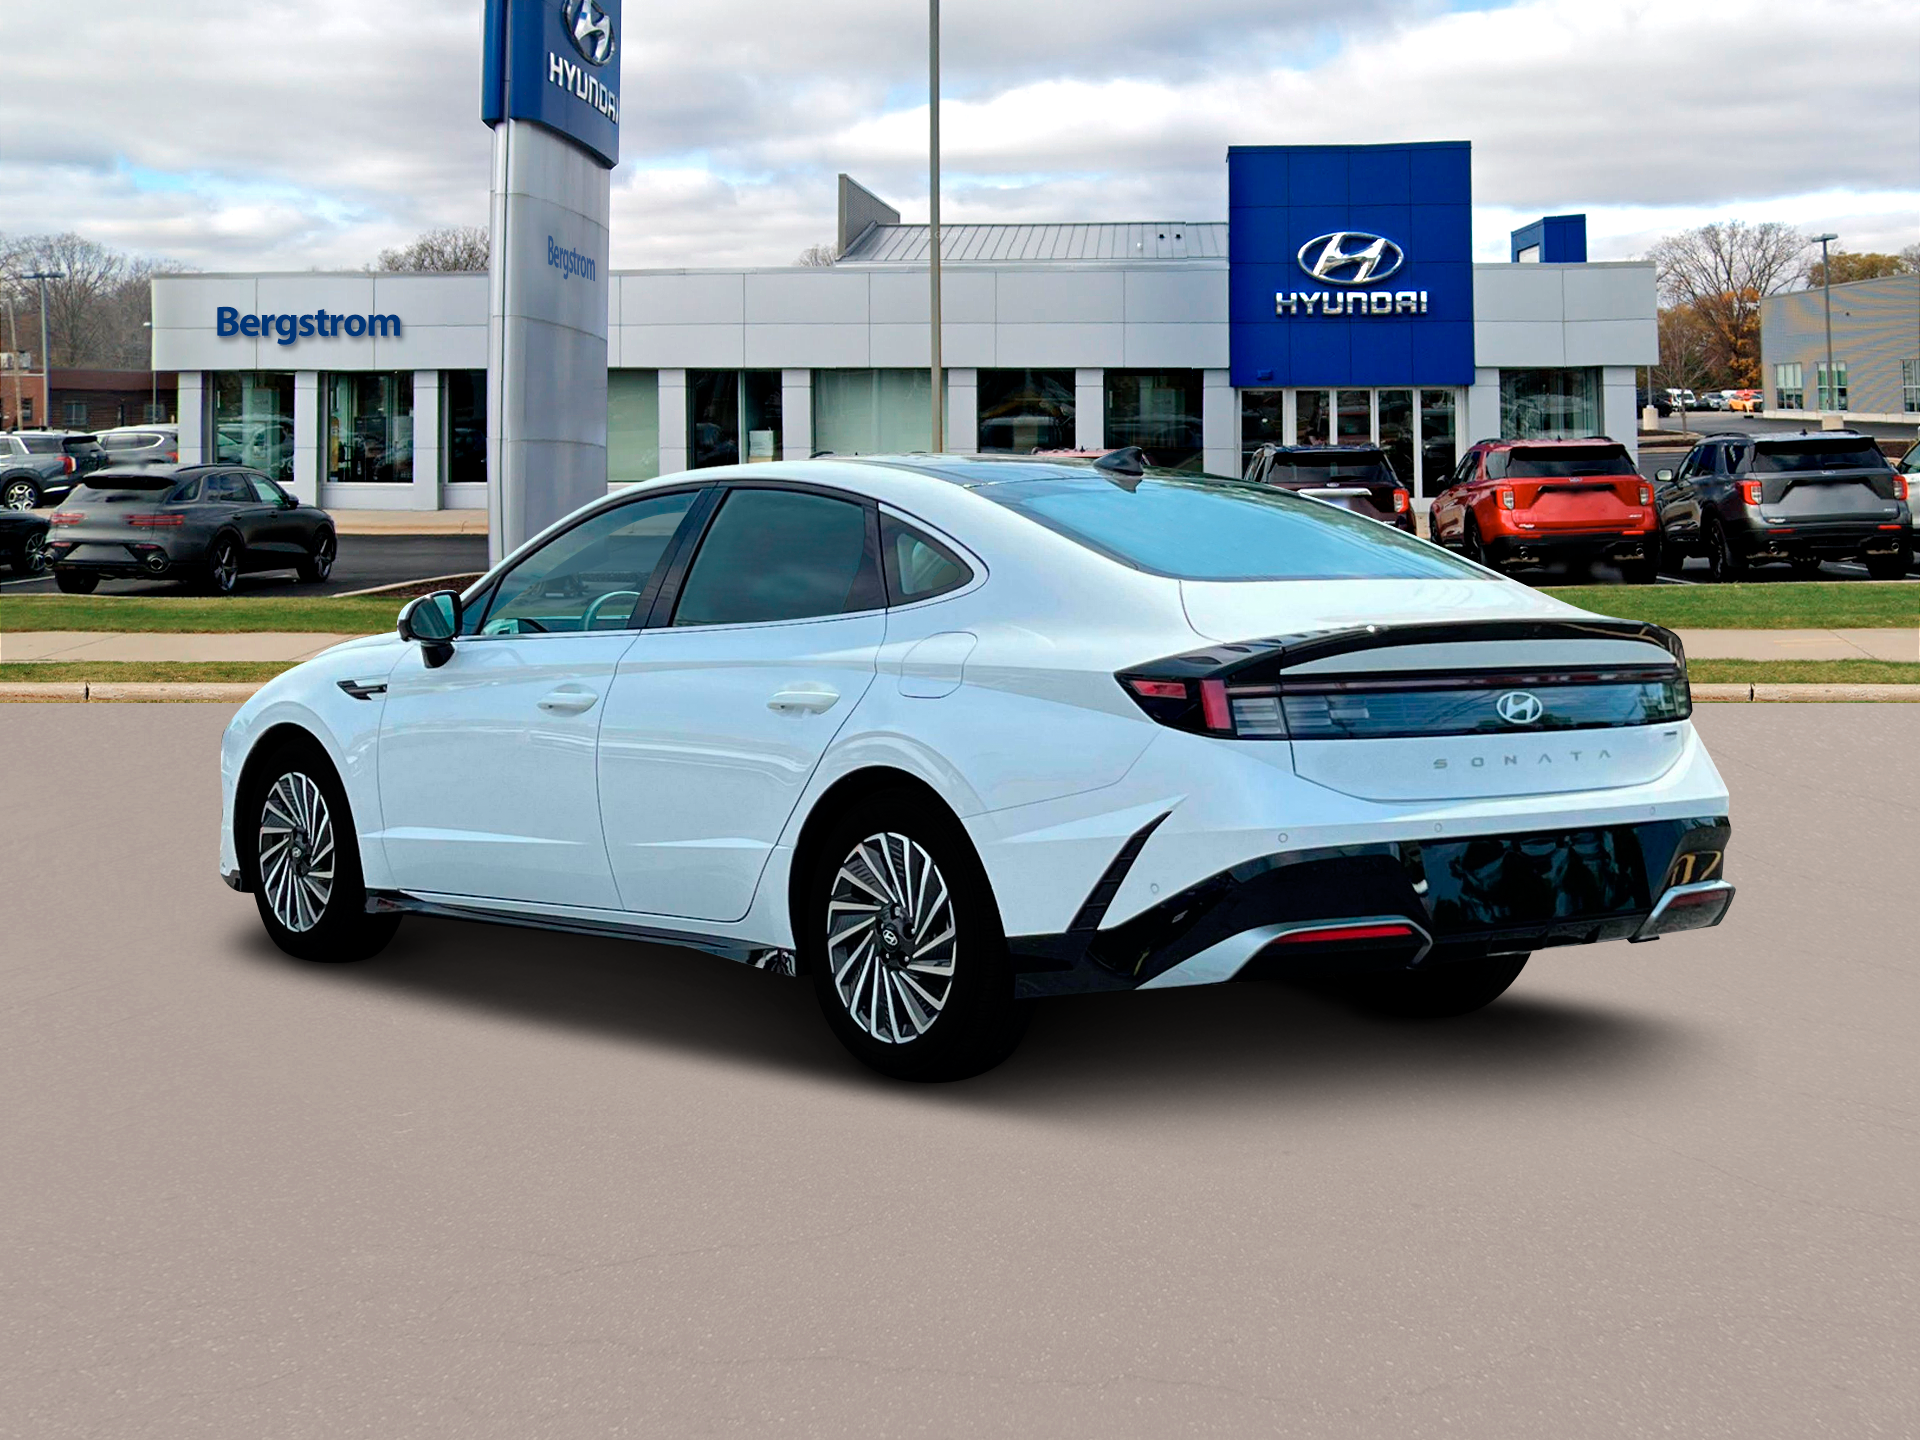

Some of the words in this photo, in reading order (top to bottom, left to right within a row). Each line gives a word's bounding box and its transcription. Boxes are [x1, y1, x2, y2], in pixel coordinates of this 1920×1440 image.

[549, 52, 618, 124] HYUNDAI
[548, 235, 595, 282] Bergstrom
[1276, 291, 1427, 314] HYUNDAI
[217, 306, 402, 346] Bergstrom
[1433, 750, 1611, 769] SONATA
